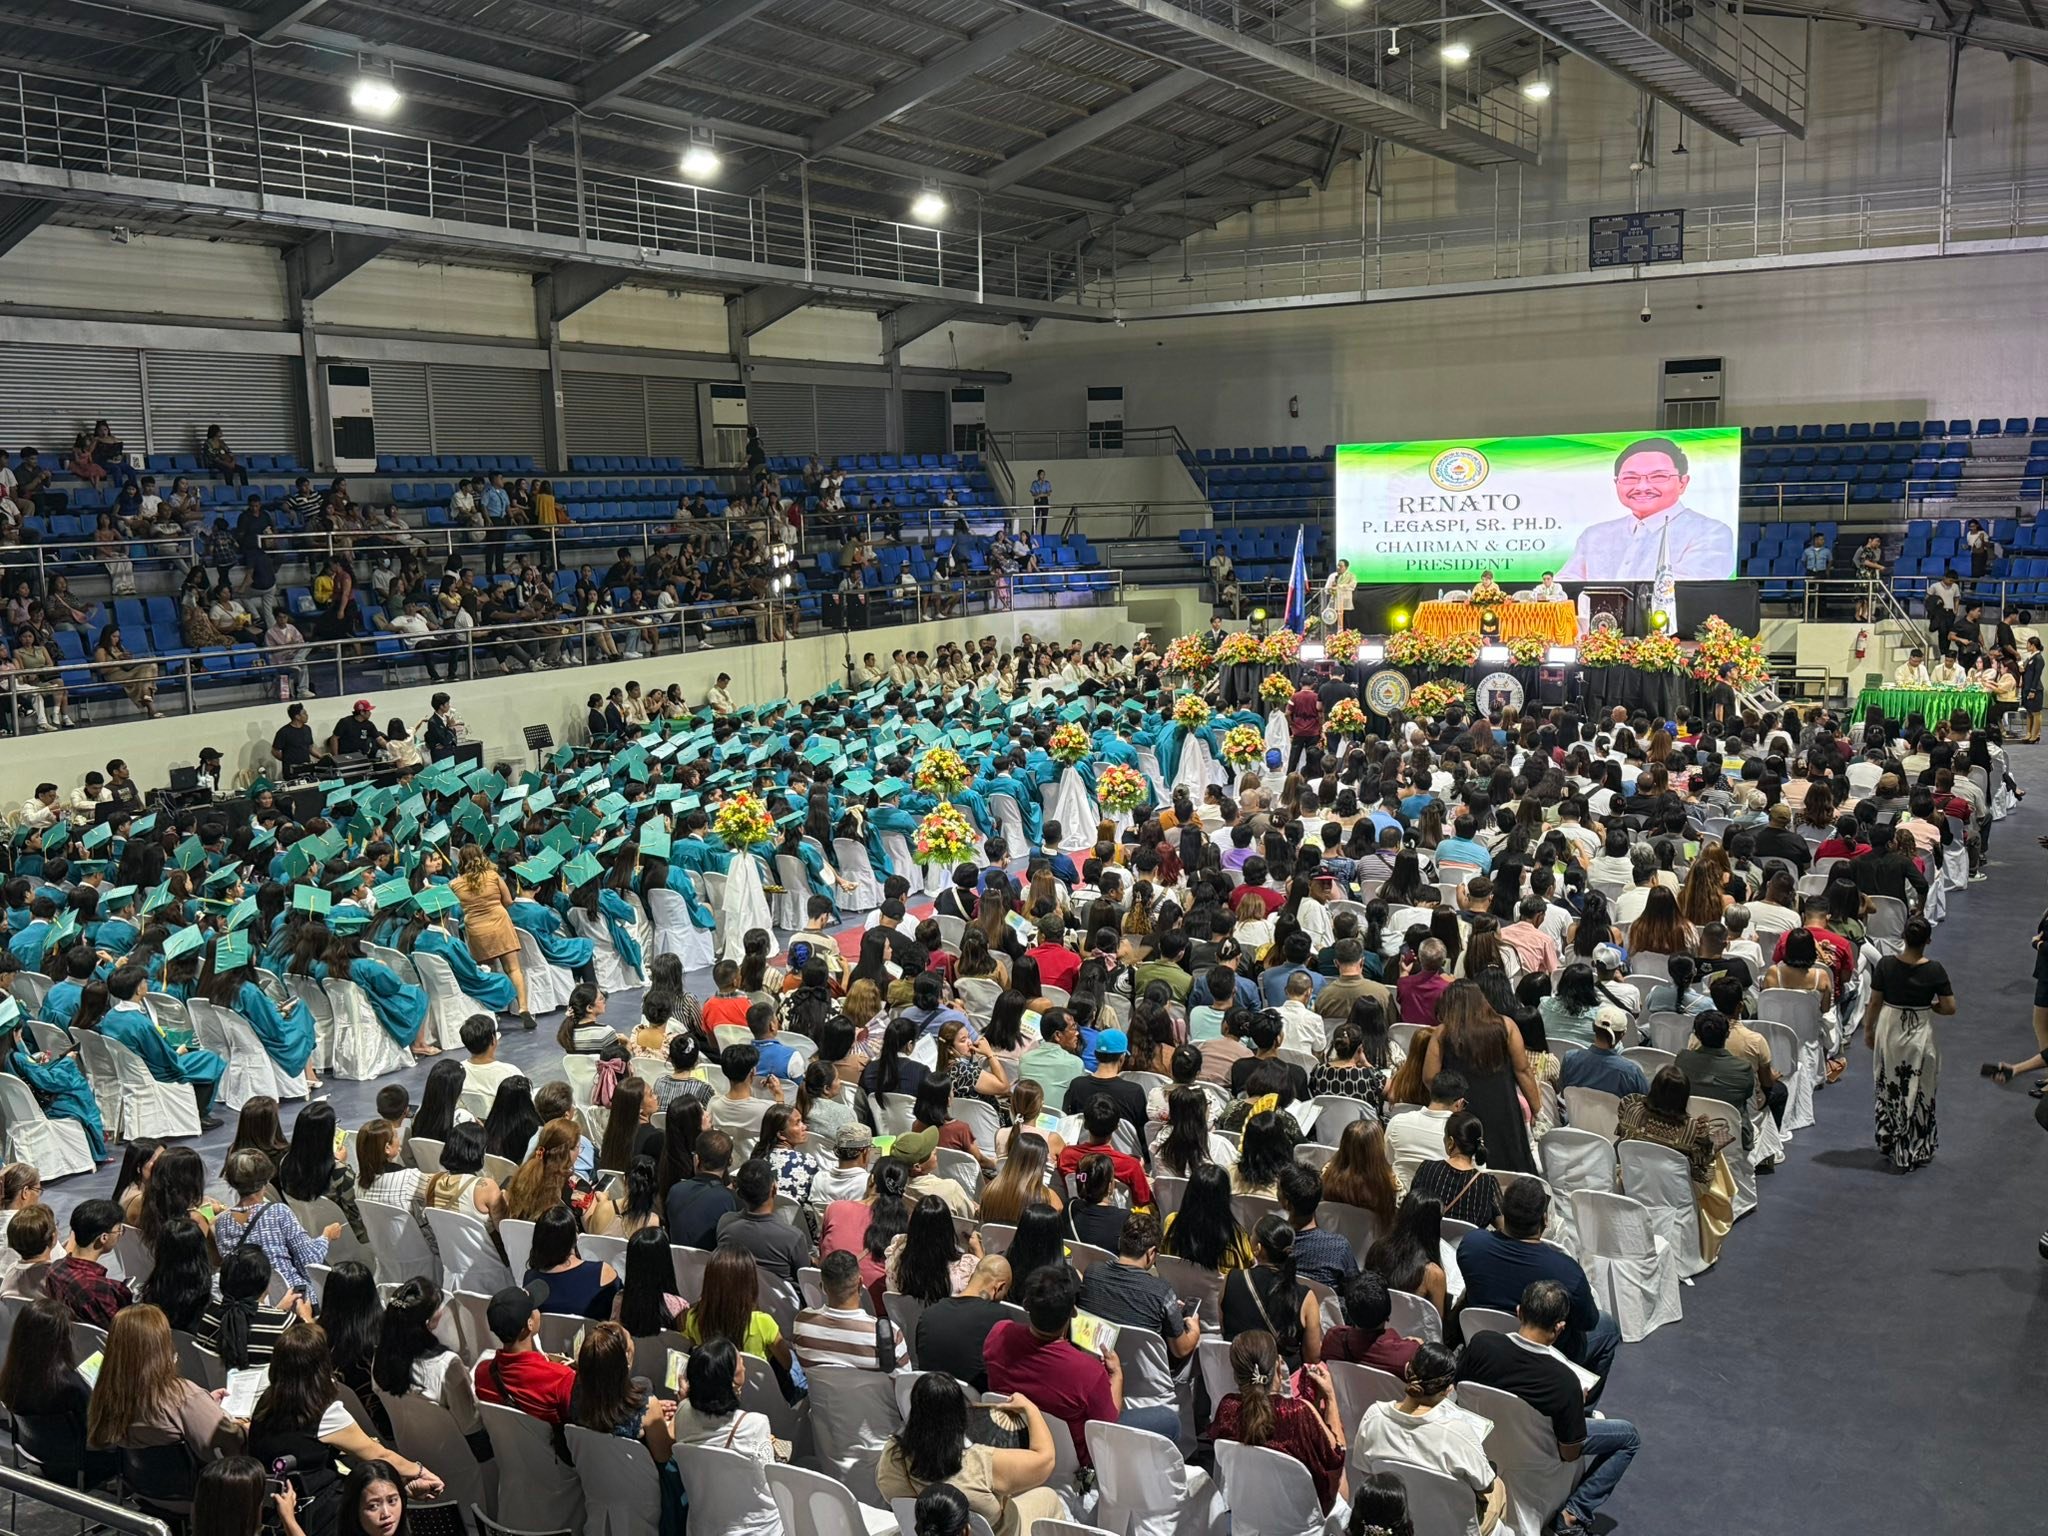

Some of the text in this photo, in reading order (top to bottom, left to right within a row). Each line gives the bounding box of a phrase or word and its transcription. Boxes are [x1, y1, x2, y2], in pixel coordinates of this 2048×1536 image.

[1399, 494, 1521, 514] RENATO
[1362, 516, 1562, 534] P. LEGASPI, SR. PH.D.
[1375, 538, 1546, 553] CHAIRMAN & CEO
[1406, 558, 1514, 571] PRESIDENT
